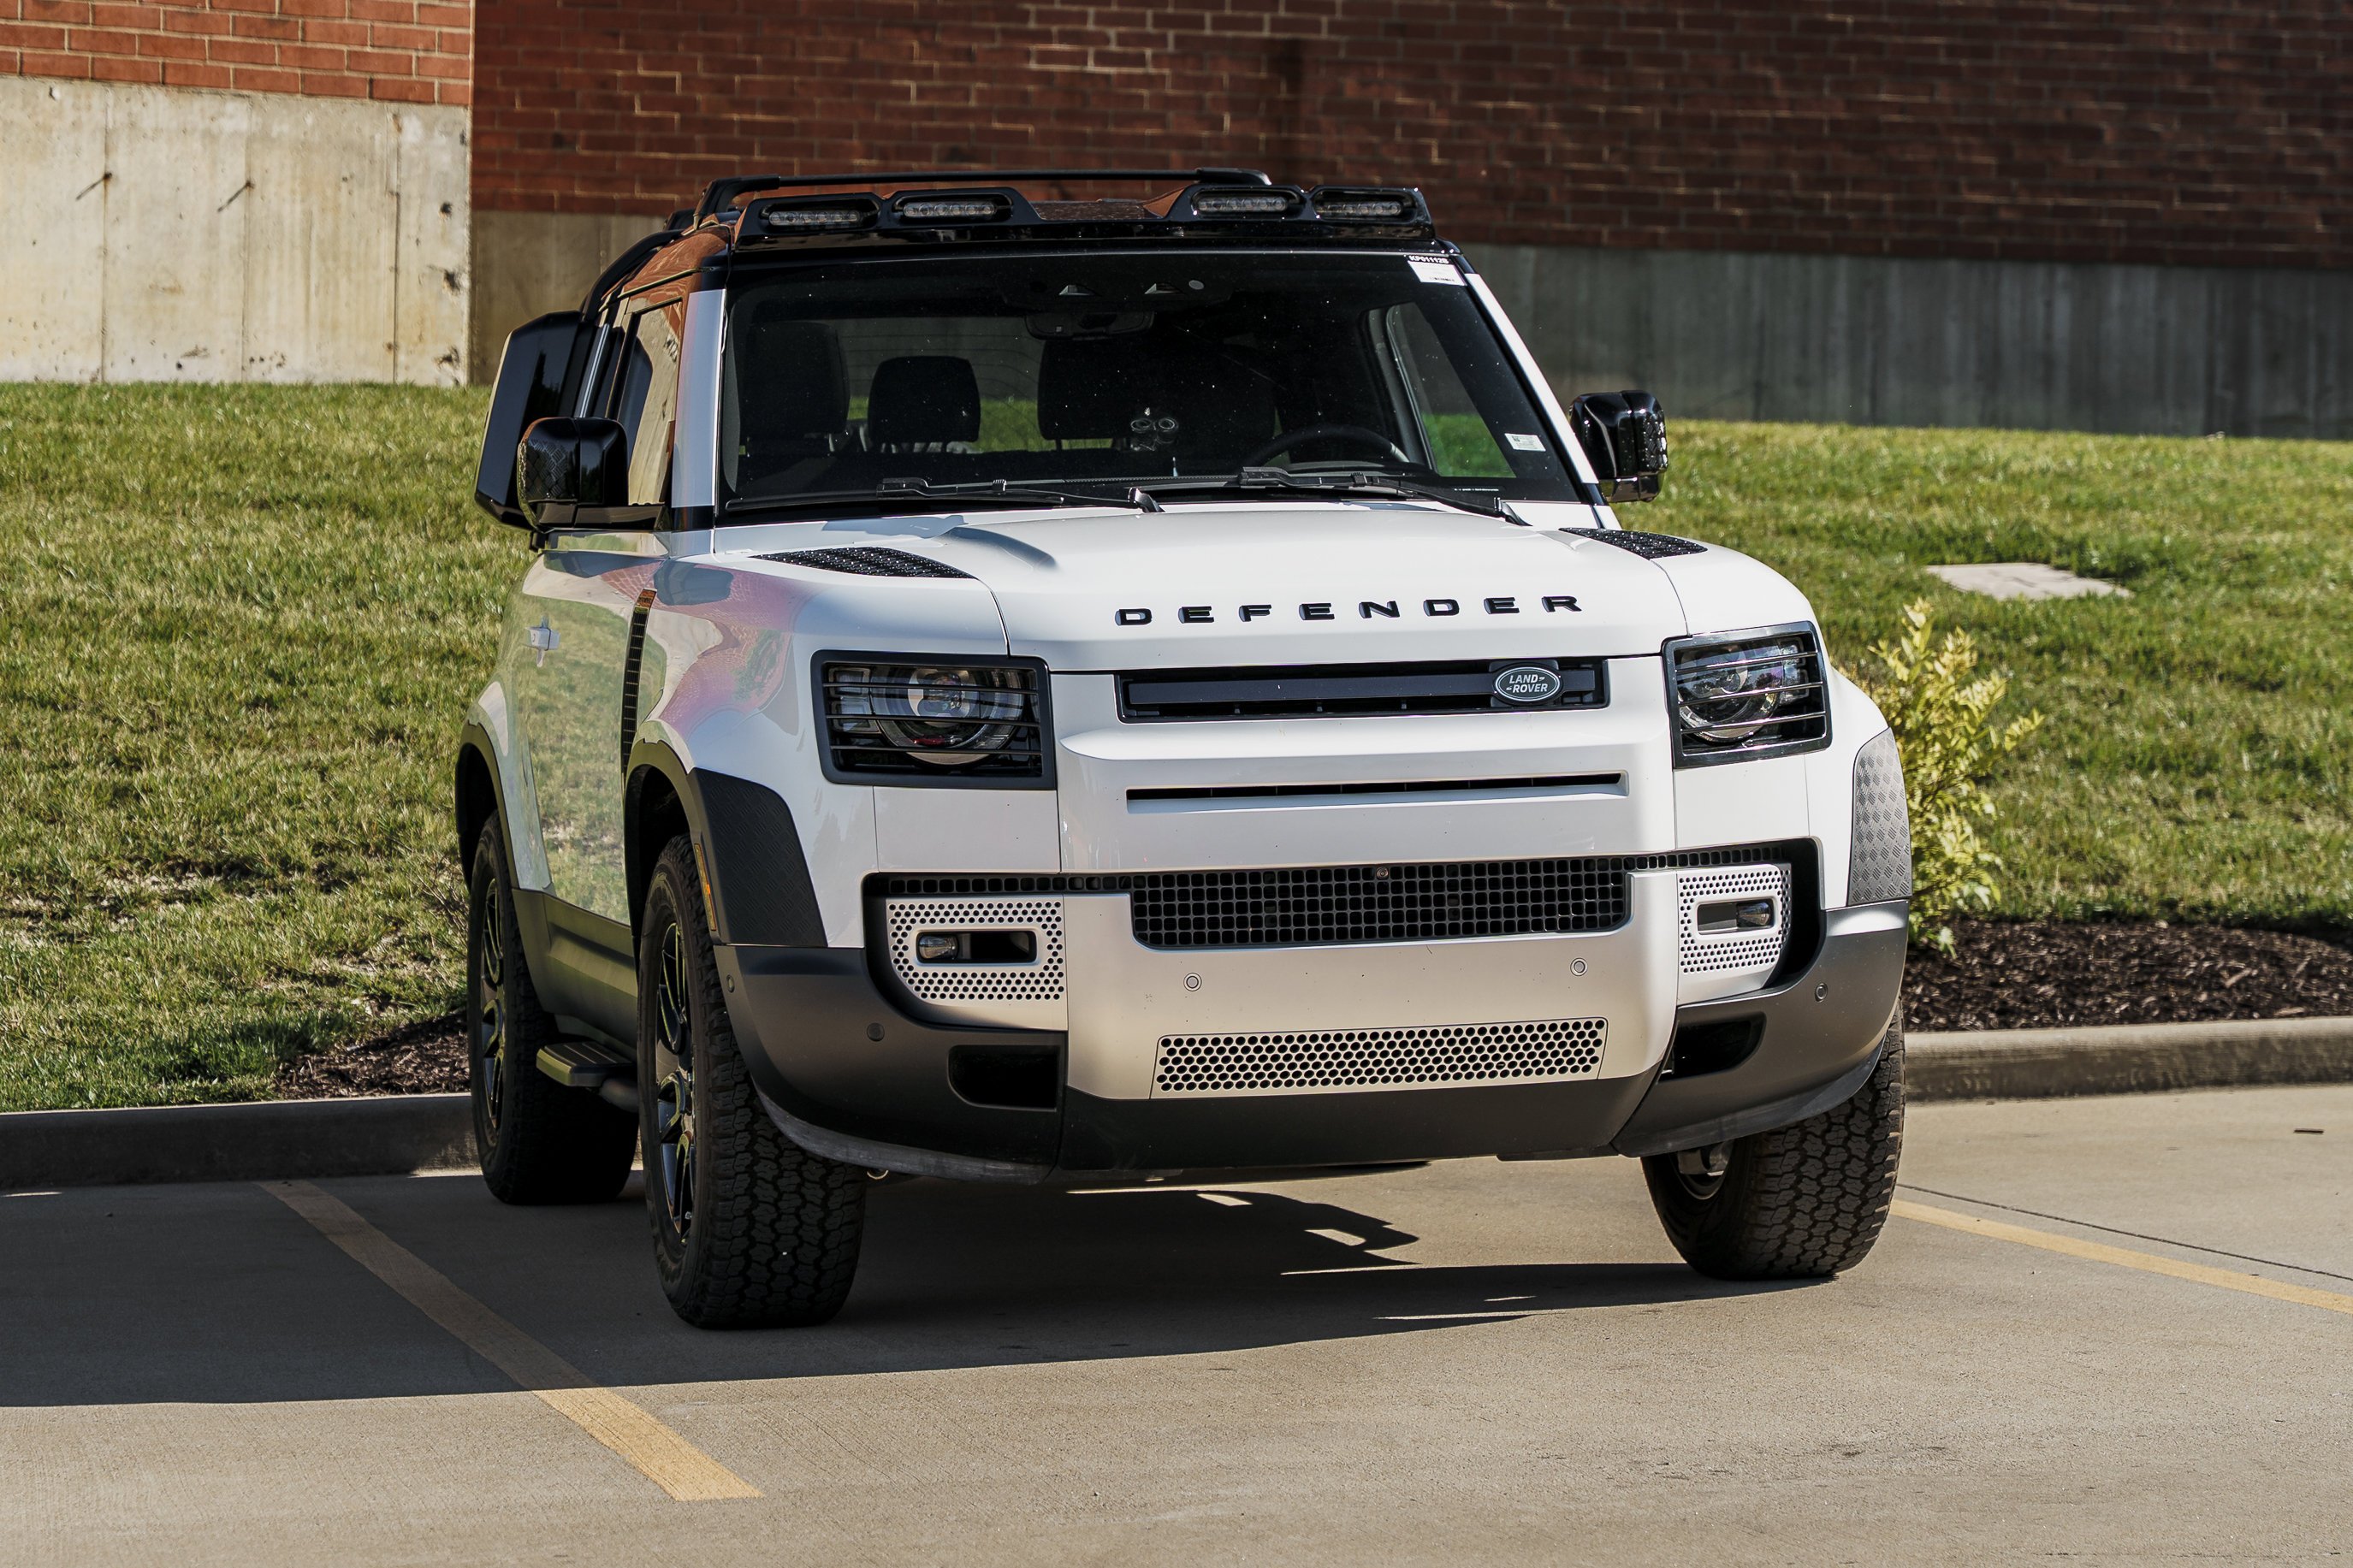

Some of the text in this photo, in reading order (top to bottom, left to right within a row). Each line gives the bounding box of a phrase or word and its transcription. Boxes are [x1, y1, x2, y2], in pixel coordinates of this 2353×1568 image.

[1115, 596, 1582, 626] DEFENDER
[1509, 674, 1538, 683] LAND
[1513, 683, 1548, 693] ROVER
